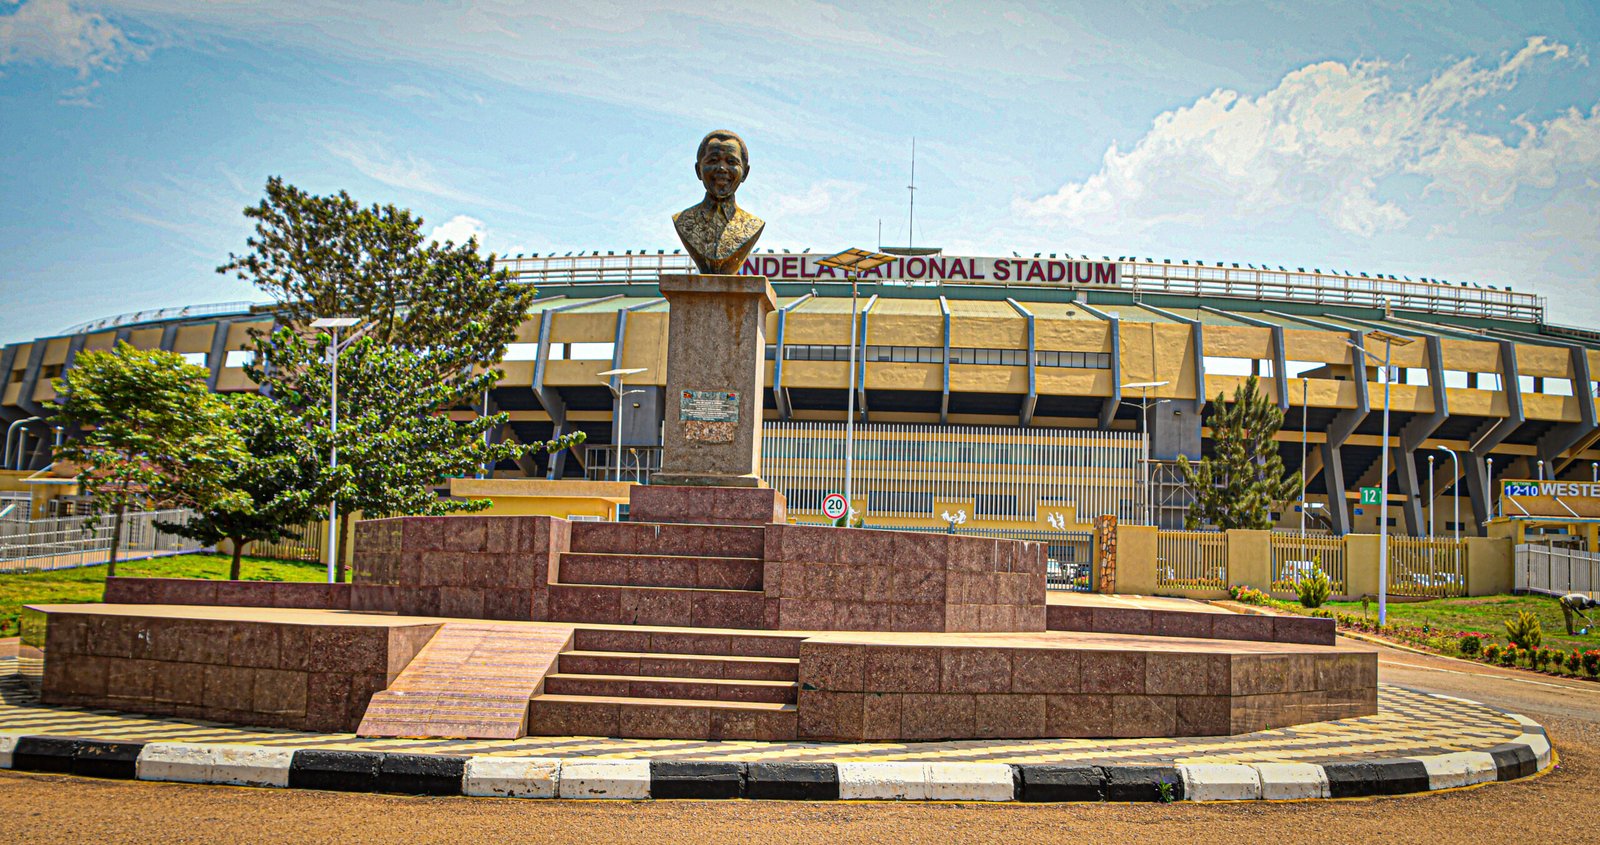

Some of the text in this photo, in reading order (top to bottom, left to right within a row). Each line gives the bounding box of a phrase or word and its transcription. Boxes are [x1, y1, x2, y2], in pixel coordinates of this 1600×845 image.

[738, 256, 836, 278] NDELA
[993, 259, 1116, 284] STADIUM
[1505, 485, 1538, 496] 12-10
[828, 499, 843, 510] 20
